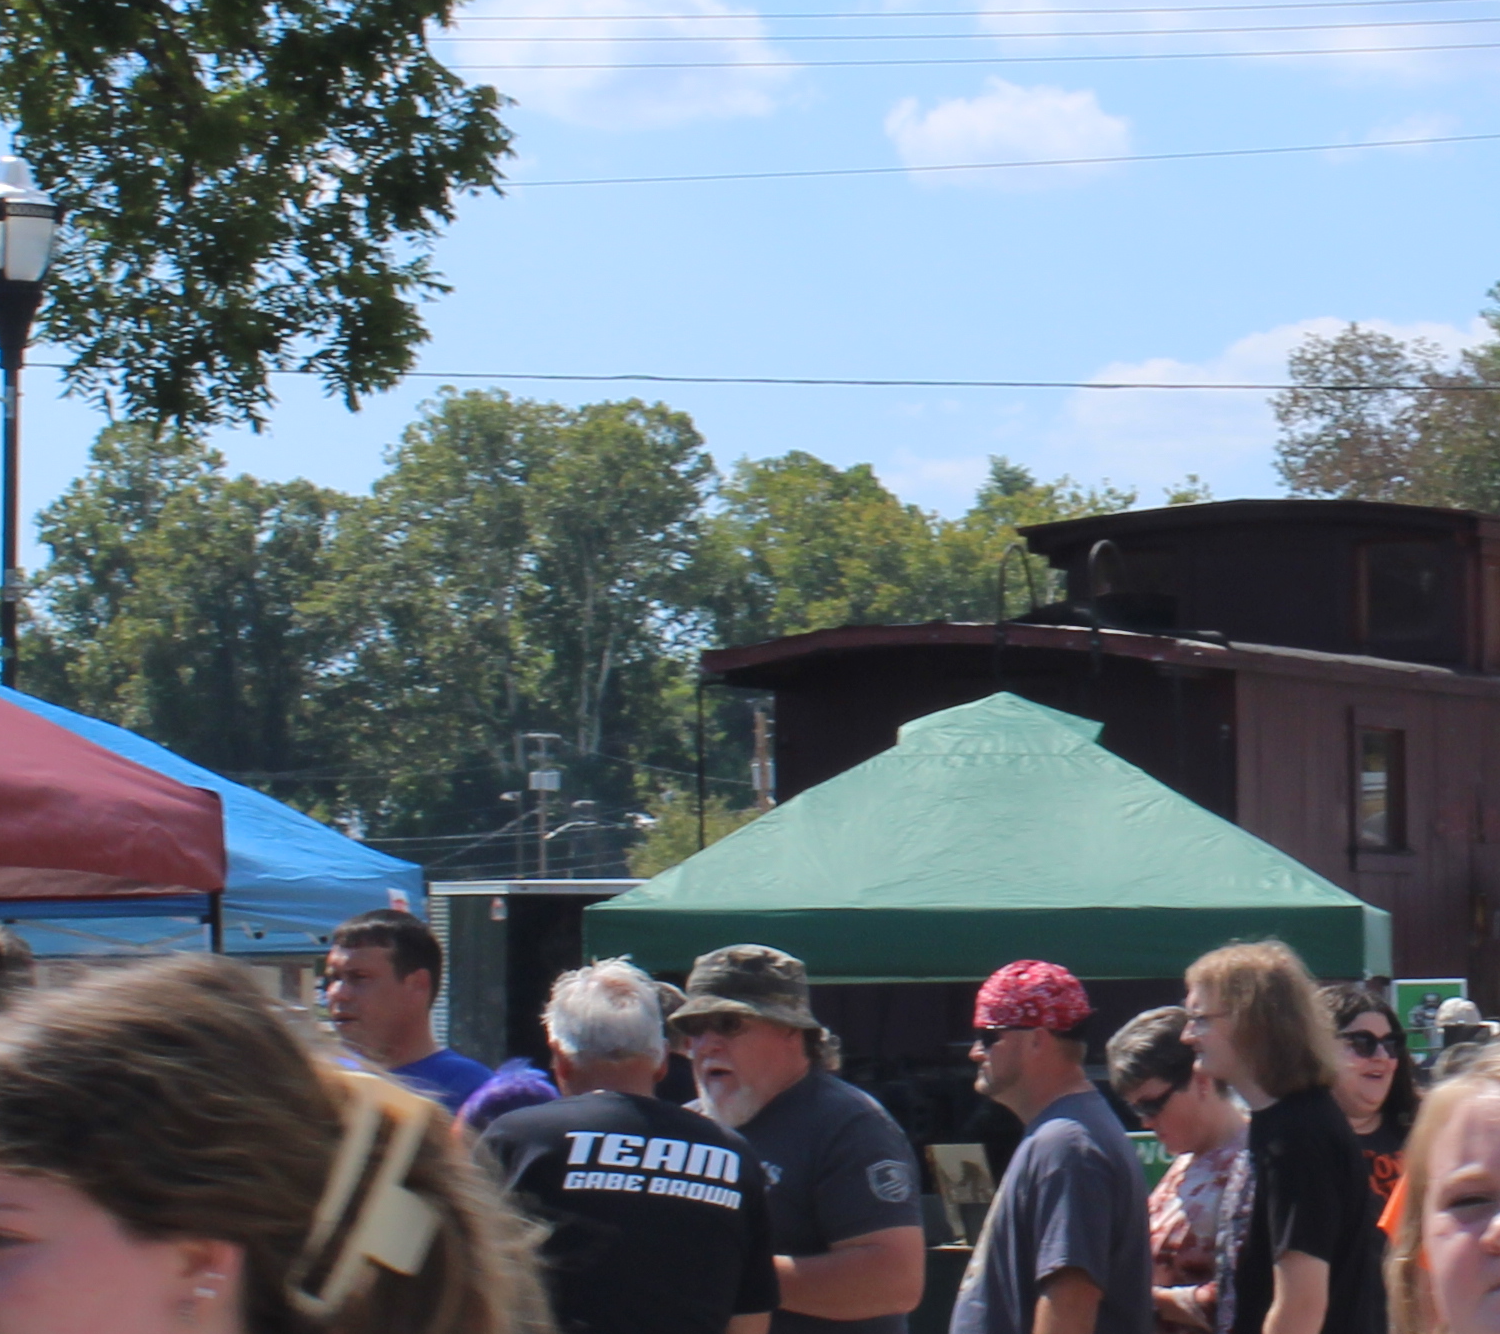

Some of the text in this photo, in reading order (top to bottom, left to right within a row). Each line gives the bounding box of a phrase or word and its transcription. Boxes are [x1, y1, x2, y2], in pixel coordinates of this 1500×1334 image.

[564, 1131, 740, 1184] TEAM
[562, 1171, 743, 1210] GABE BROWN
